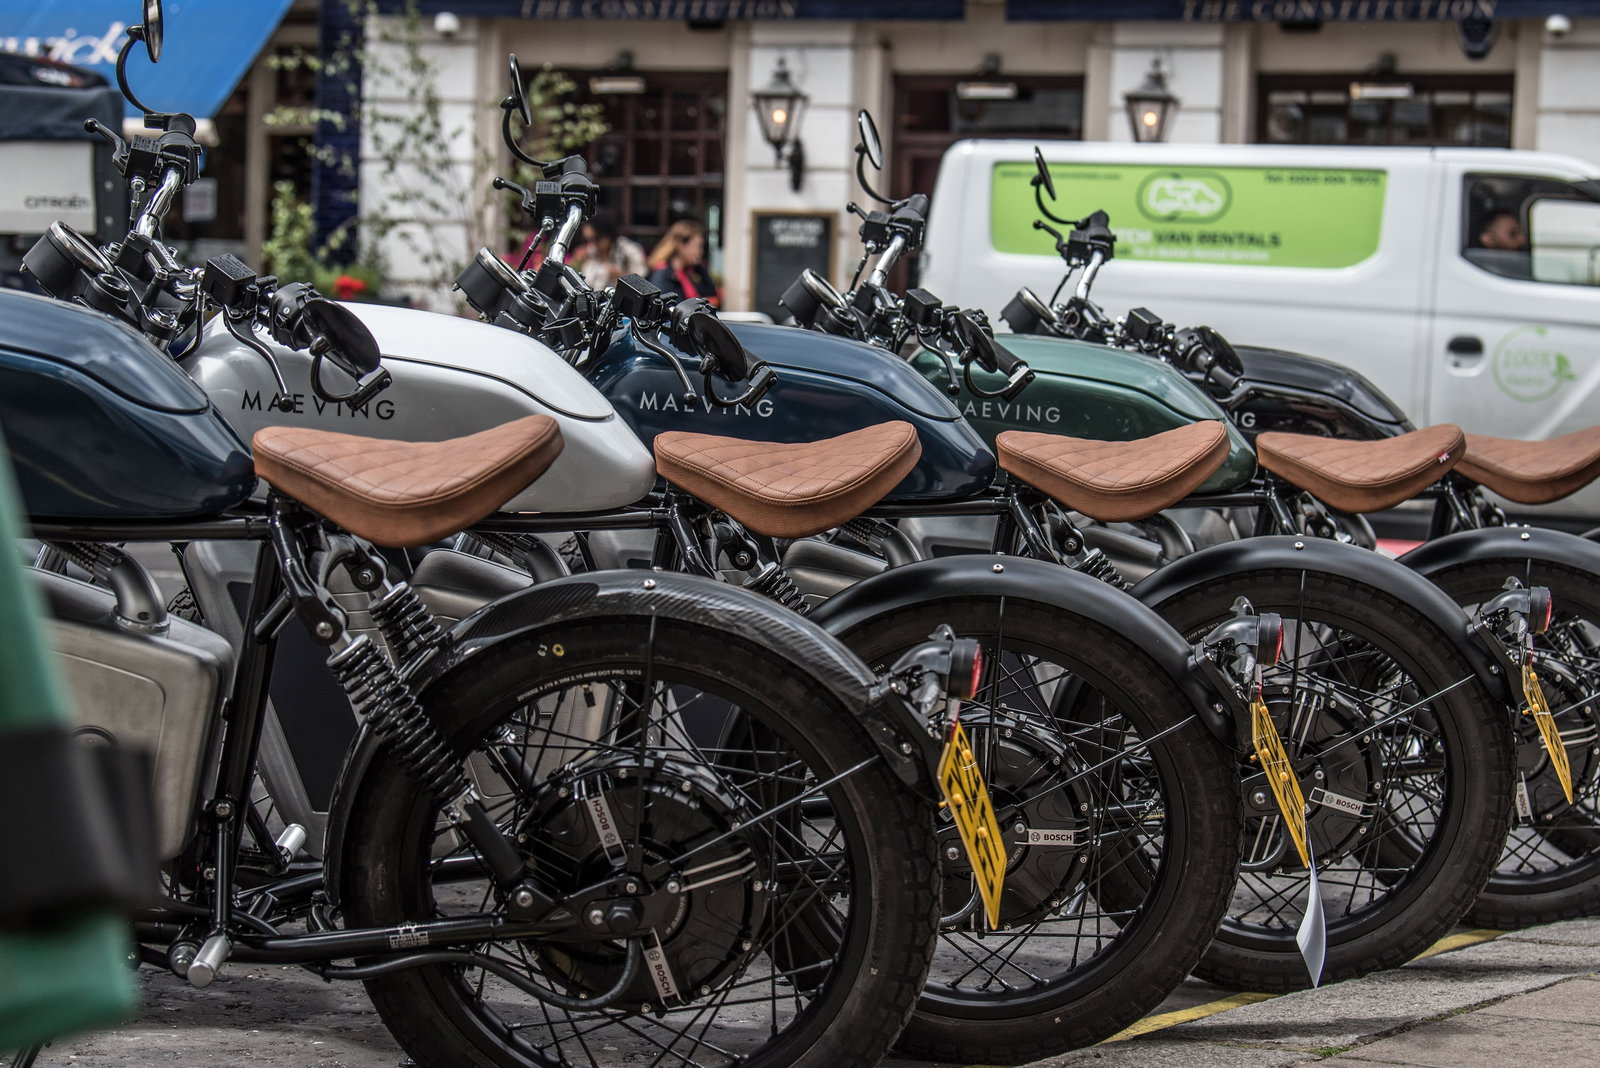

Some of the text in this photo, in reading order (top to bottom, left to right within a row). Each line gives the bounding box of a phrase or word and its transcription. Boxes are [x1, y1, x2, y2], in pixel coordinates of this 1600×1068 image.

[520, 0, 797, 19] THE CONSTITUTION
[1183, 0, 1498, 21] THE CONSTITUTION
[592, 799, 610, 831] BOSCH
[1336, 799, 1362, 811] BOSCH
[1043, 833, 1073, 841] BOSCH
[654, 963, 673, 995] BOSCH
